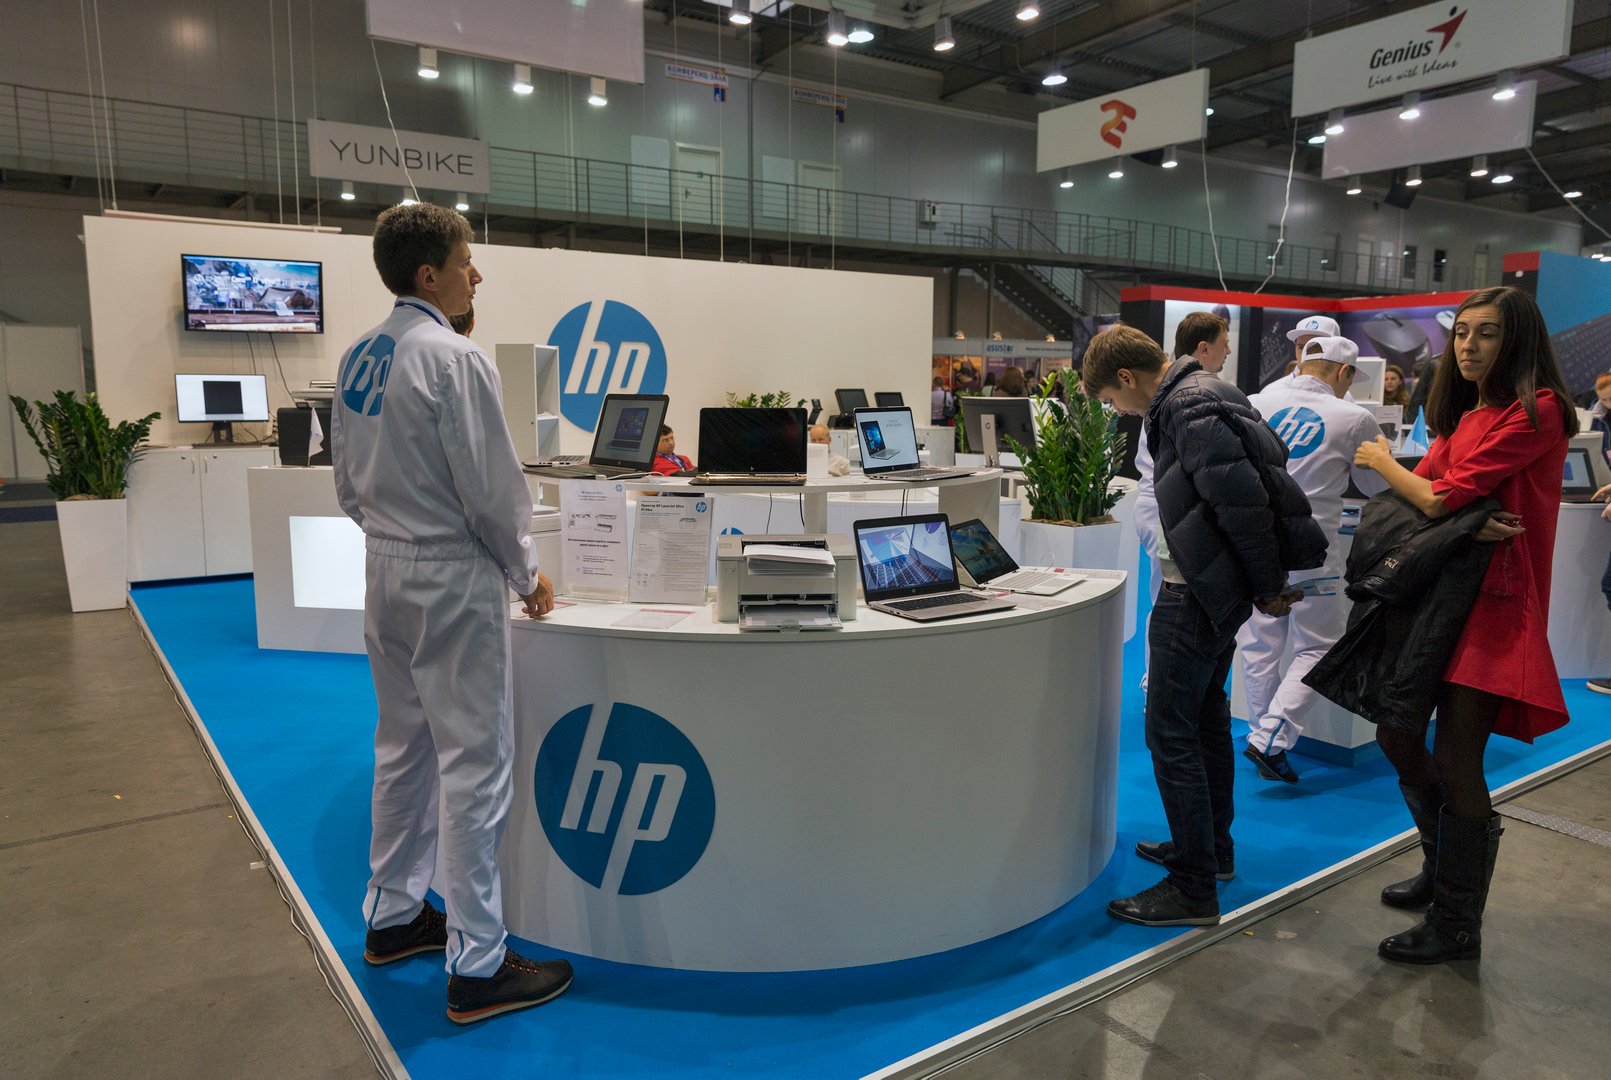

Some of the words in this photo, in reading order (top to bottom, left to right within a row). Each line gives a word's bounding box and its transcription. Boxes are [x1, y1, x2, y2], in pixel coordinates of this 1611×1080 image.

[1368, 76, 1392, 88] Live
[1396, 65, 1418, 80] with
[1422, 60, 1457, 75] Ideas
[1369, 40, 1433, 69] Genius
[329, 139, 475, 175] YUNBIKE
[343, 333, 393, 416] hp
[561, 300, 651, 404] hp
[1274, 406, 1322, 452] hp
[559, 702, 688, 894] hp
